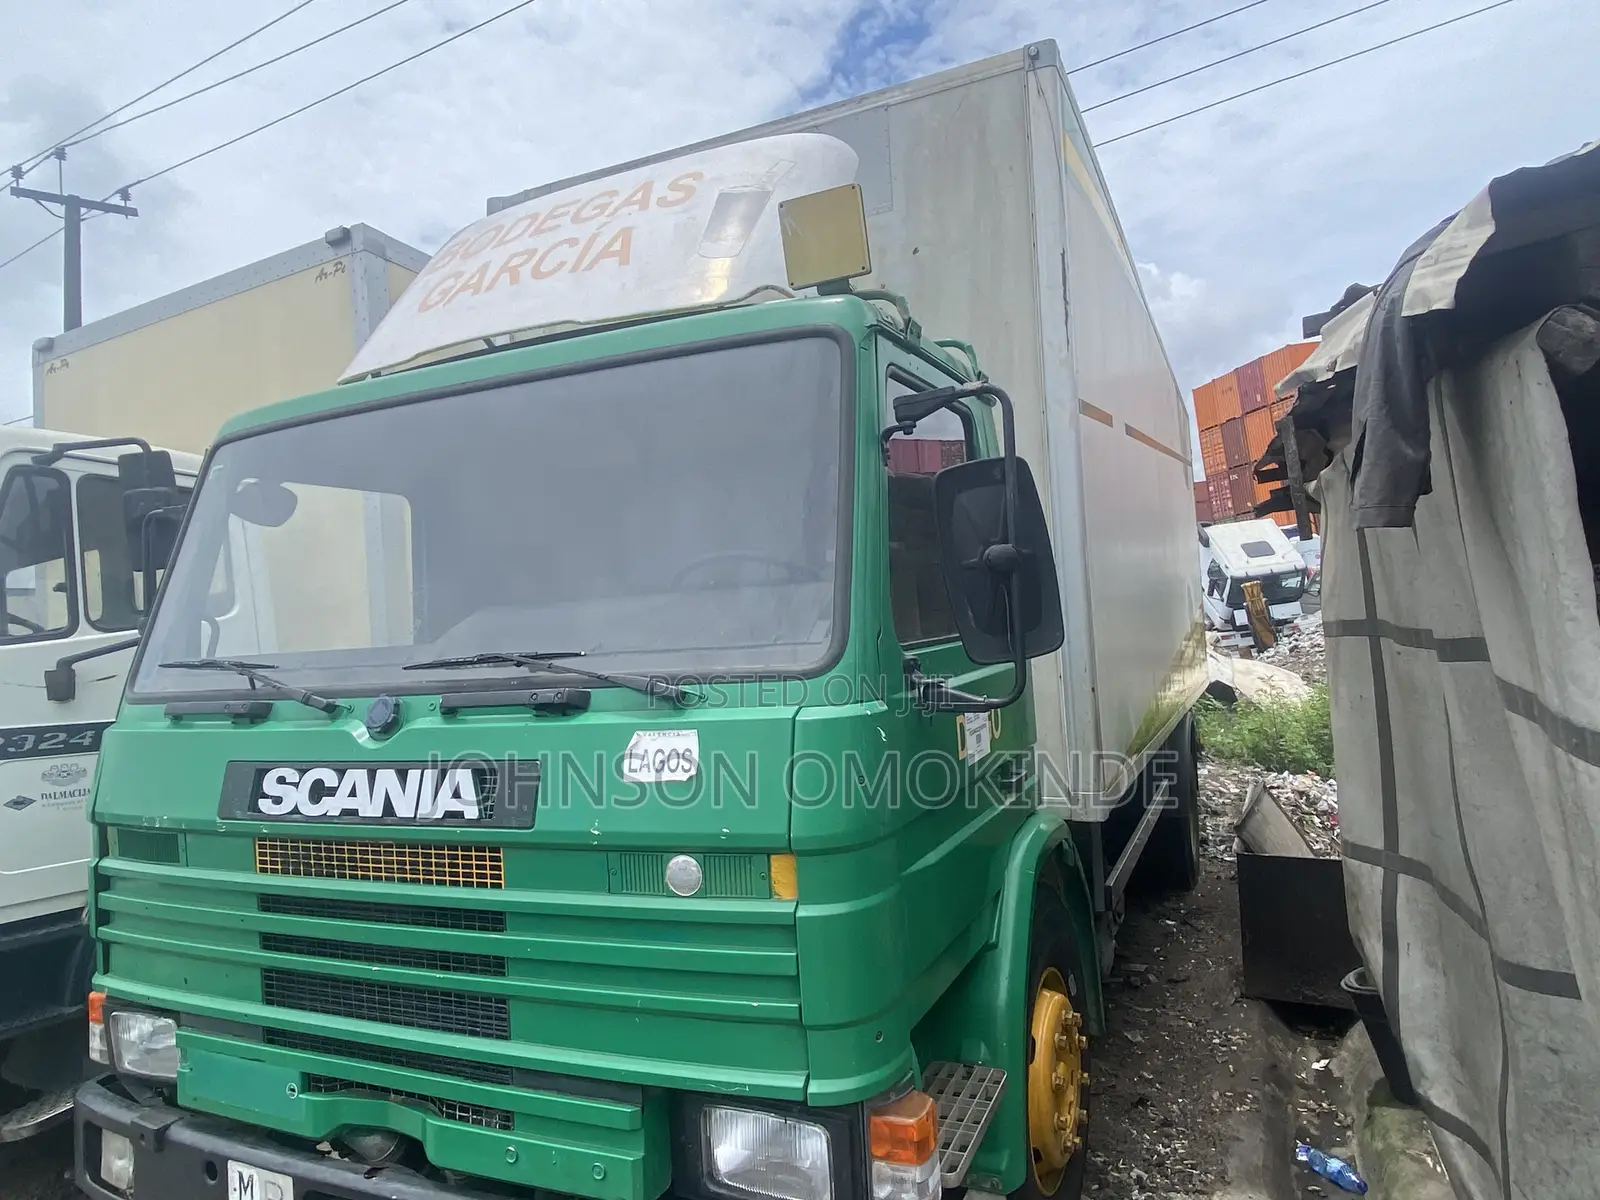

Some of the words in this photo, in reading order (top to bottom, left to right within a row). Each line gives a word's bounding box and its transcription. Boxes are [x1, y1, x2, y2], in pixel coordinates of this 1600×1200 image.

[424, 172, 704, 276] BODEGAS
[418, 221, 634, 313] GARCÍA
[258, 767, 480, 820] SCANIA
[628, 748, 693, 774] LAGOS
